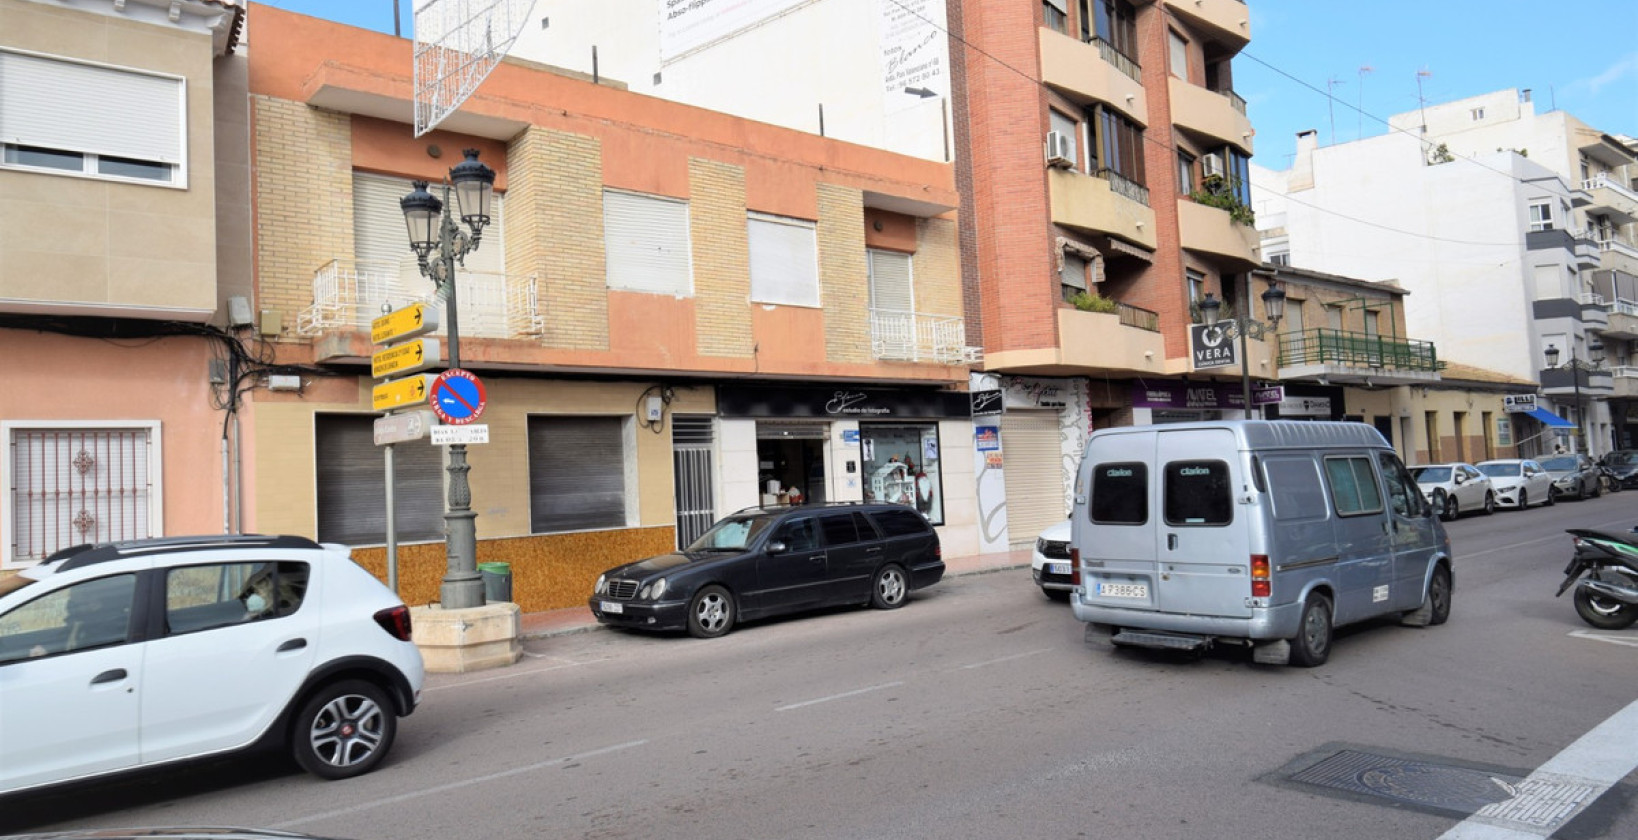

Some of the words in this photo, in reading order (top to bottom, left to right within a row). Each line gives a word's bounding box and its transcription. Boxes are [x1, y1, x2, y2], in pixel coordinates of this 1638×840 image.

[1196, 347, 1231, 361] VERA
[440, 369, 476, 381] EXCEPTO
[432, 394, 446, 419] CARGA
